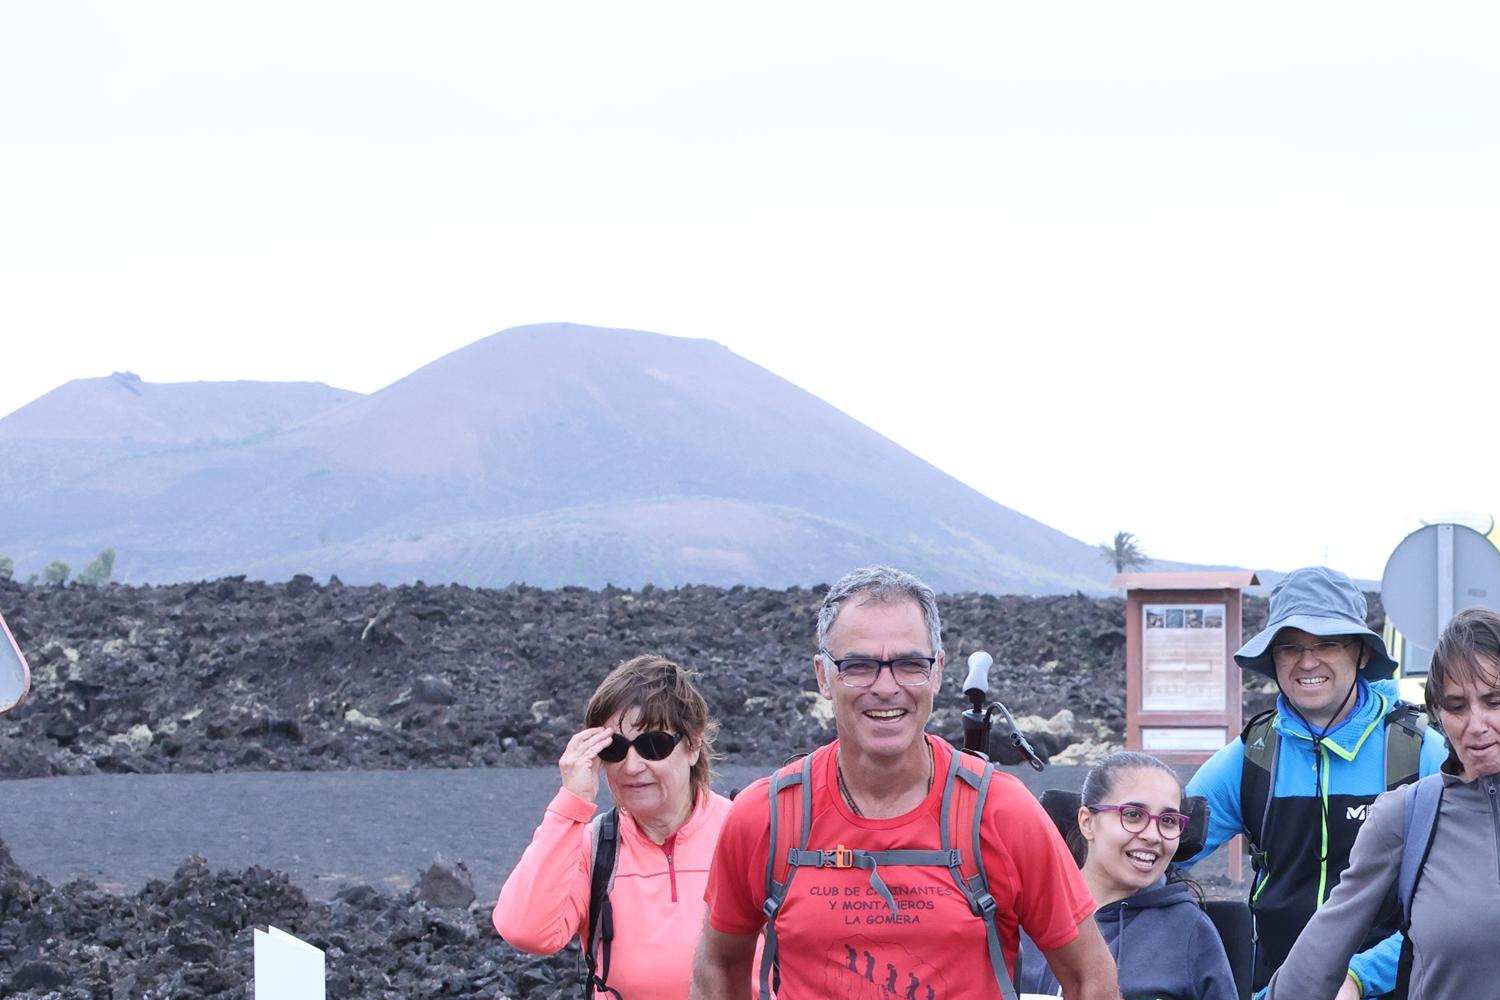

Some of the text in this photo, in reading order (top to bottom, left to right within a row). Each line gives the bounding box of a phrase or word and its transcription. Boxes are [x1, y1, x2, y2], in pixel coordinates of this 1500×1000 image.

[810, 886, 952, 897] CLUB DE CINANTES
[829, 900, 837, 910] Y
[845, 915, 920, 925] LA GOMERA
